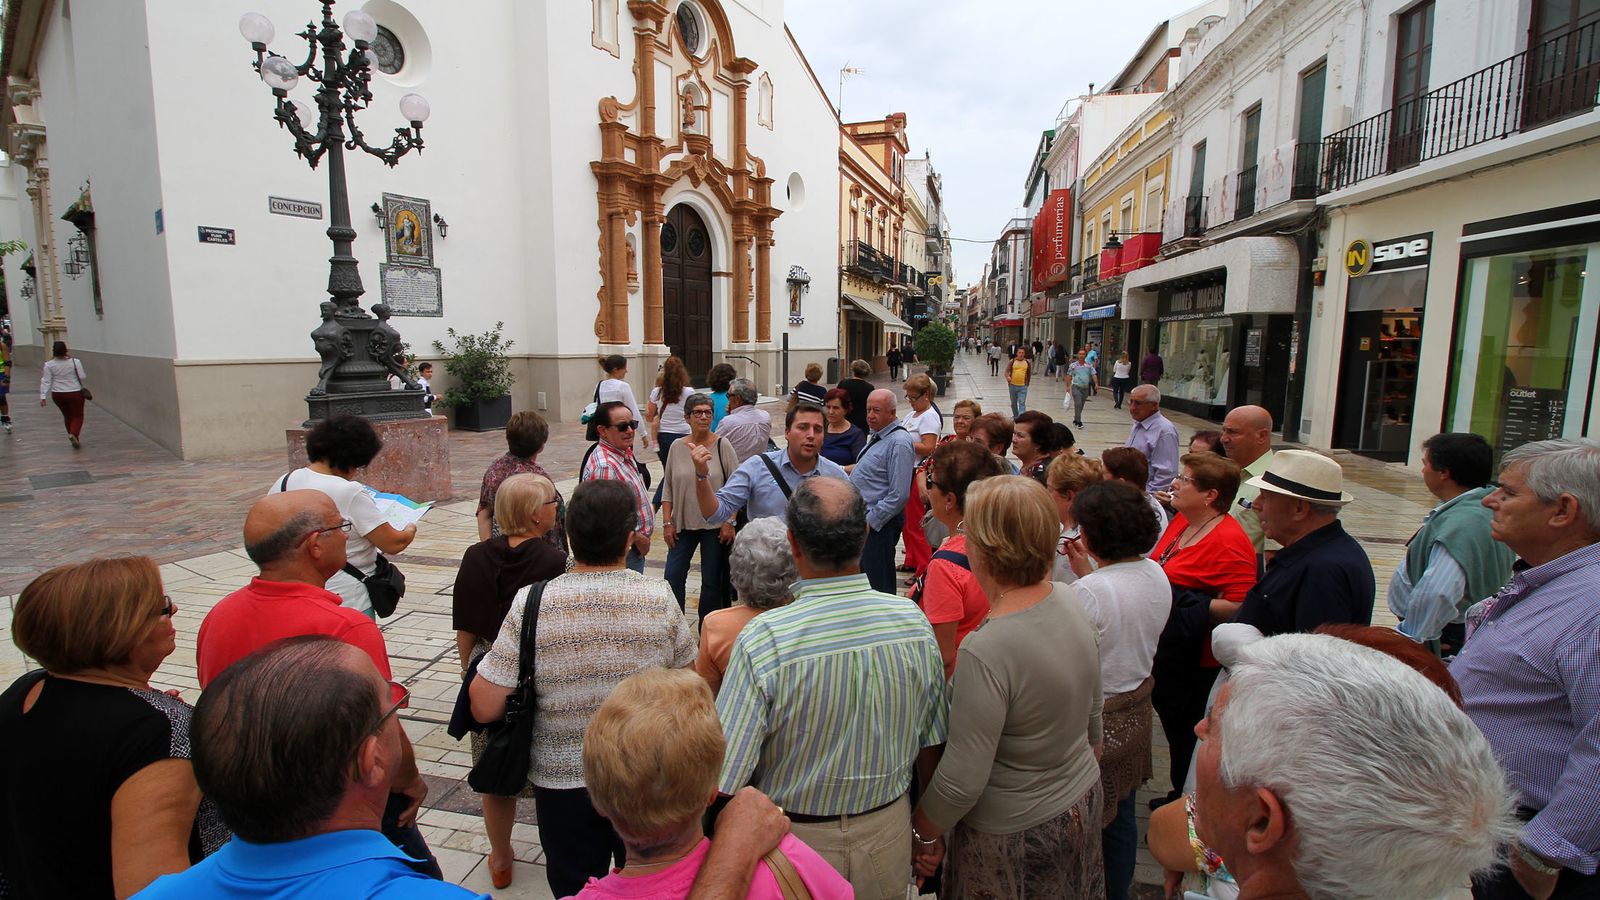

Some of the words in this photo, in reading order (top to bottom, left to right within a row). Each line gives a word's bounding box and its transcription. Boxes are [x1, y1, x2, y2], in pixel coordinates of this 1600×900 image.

[272, 200, 321, 215] CONCEPCION
[1052, 196, 1066, 261] perfumerías
[1171, 288, 1193, 312] ANDRÉS
[1196, 283, 1224, 308] MACÍAS
[1510, 390, 1537, 398] outlet
